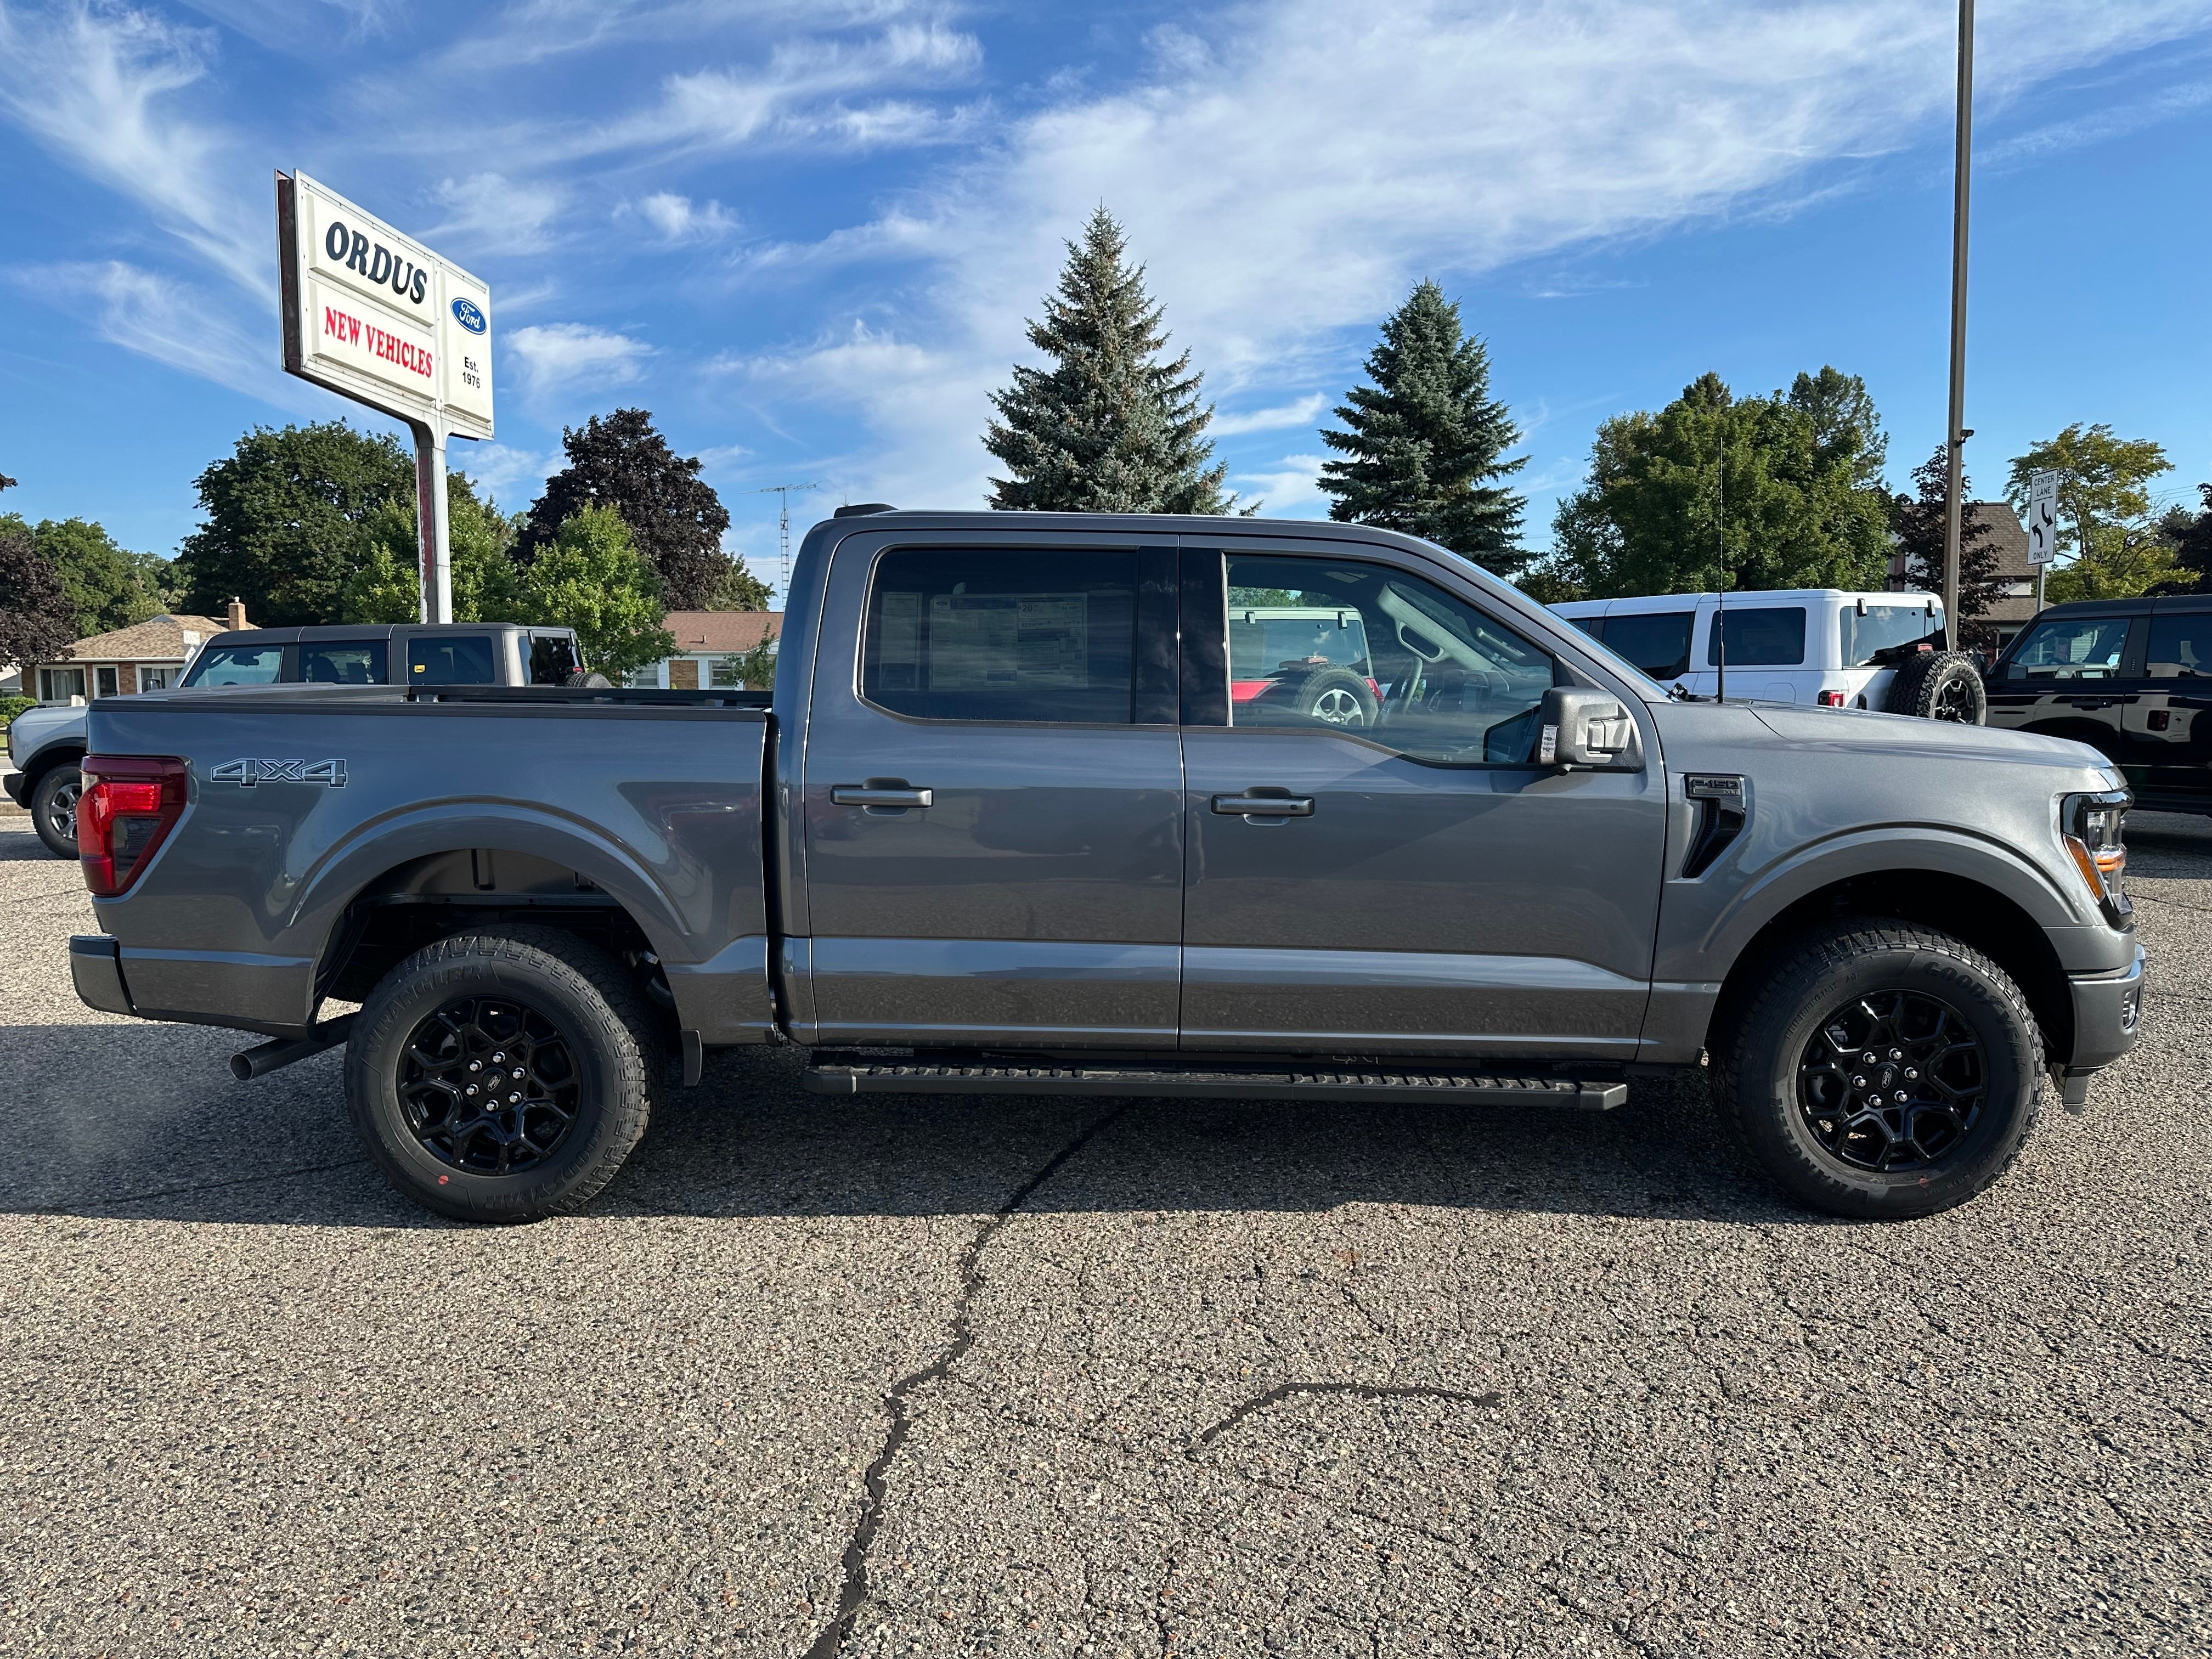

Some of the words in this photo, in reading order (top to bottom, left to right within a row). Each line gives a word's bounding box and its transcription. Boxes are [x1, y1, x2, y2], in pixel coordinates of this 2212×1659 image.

[326, 222, 427, 304] ORDUS
[325, 306, 362, 347] NEW
[365, 324, 432, 378] VEHICLES
[464, 356, 479, 373] Est.
[462, 371, 481, 389] 1976
[2034, 475, 2055, 487] CENTER
[2036, 486, 2051, 496] LANE
[2033, 550, 2047, 560] ONLY
[1691, 779, 1739, 789] F-150
[365, 964, 482, 1053] WRANGLER
[1783, 983, 1837, 1039] TERRITORY
[1922, 961, 2027, 1074] GOODYEAR
[485, 1120, 606, 1210] GOODYEAR
[1769, 1097, 1869, 1203] WRANGLER
